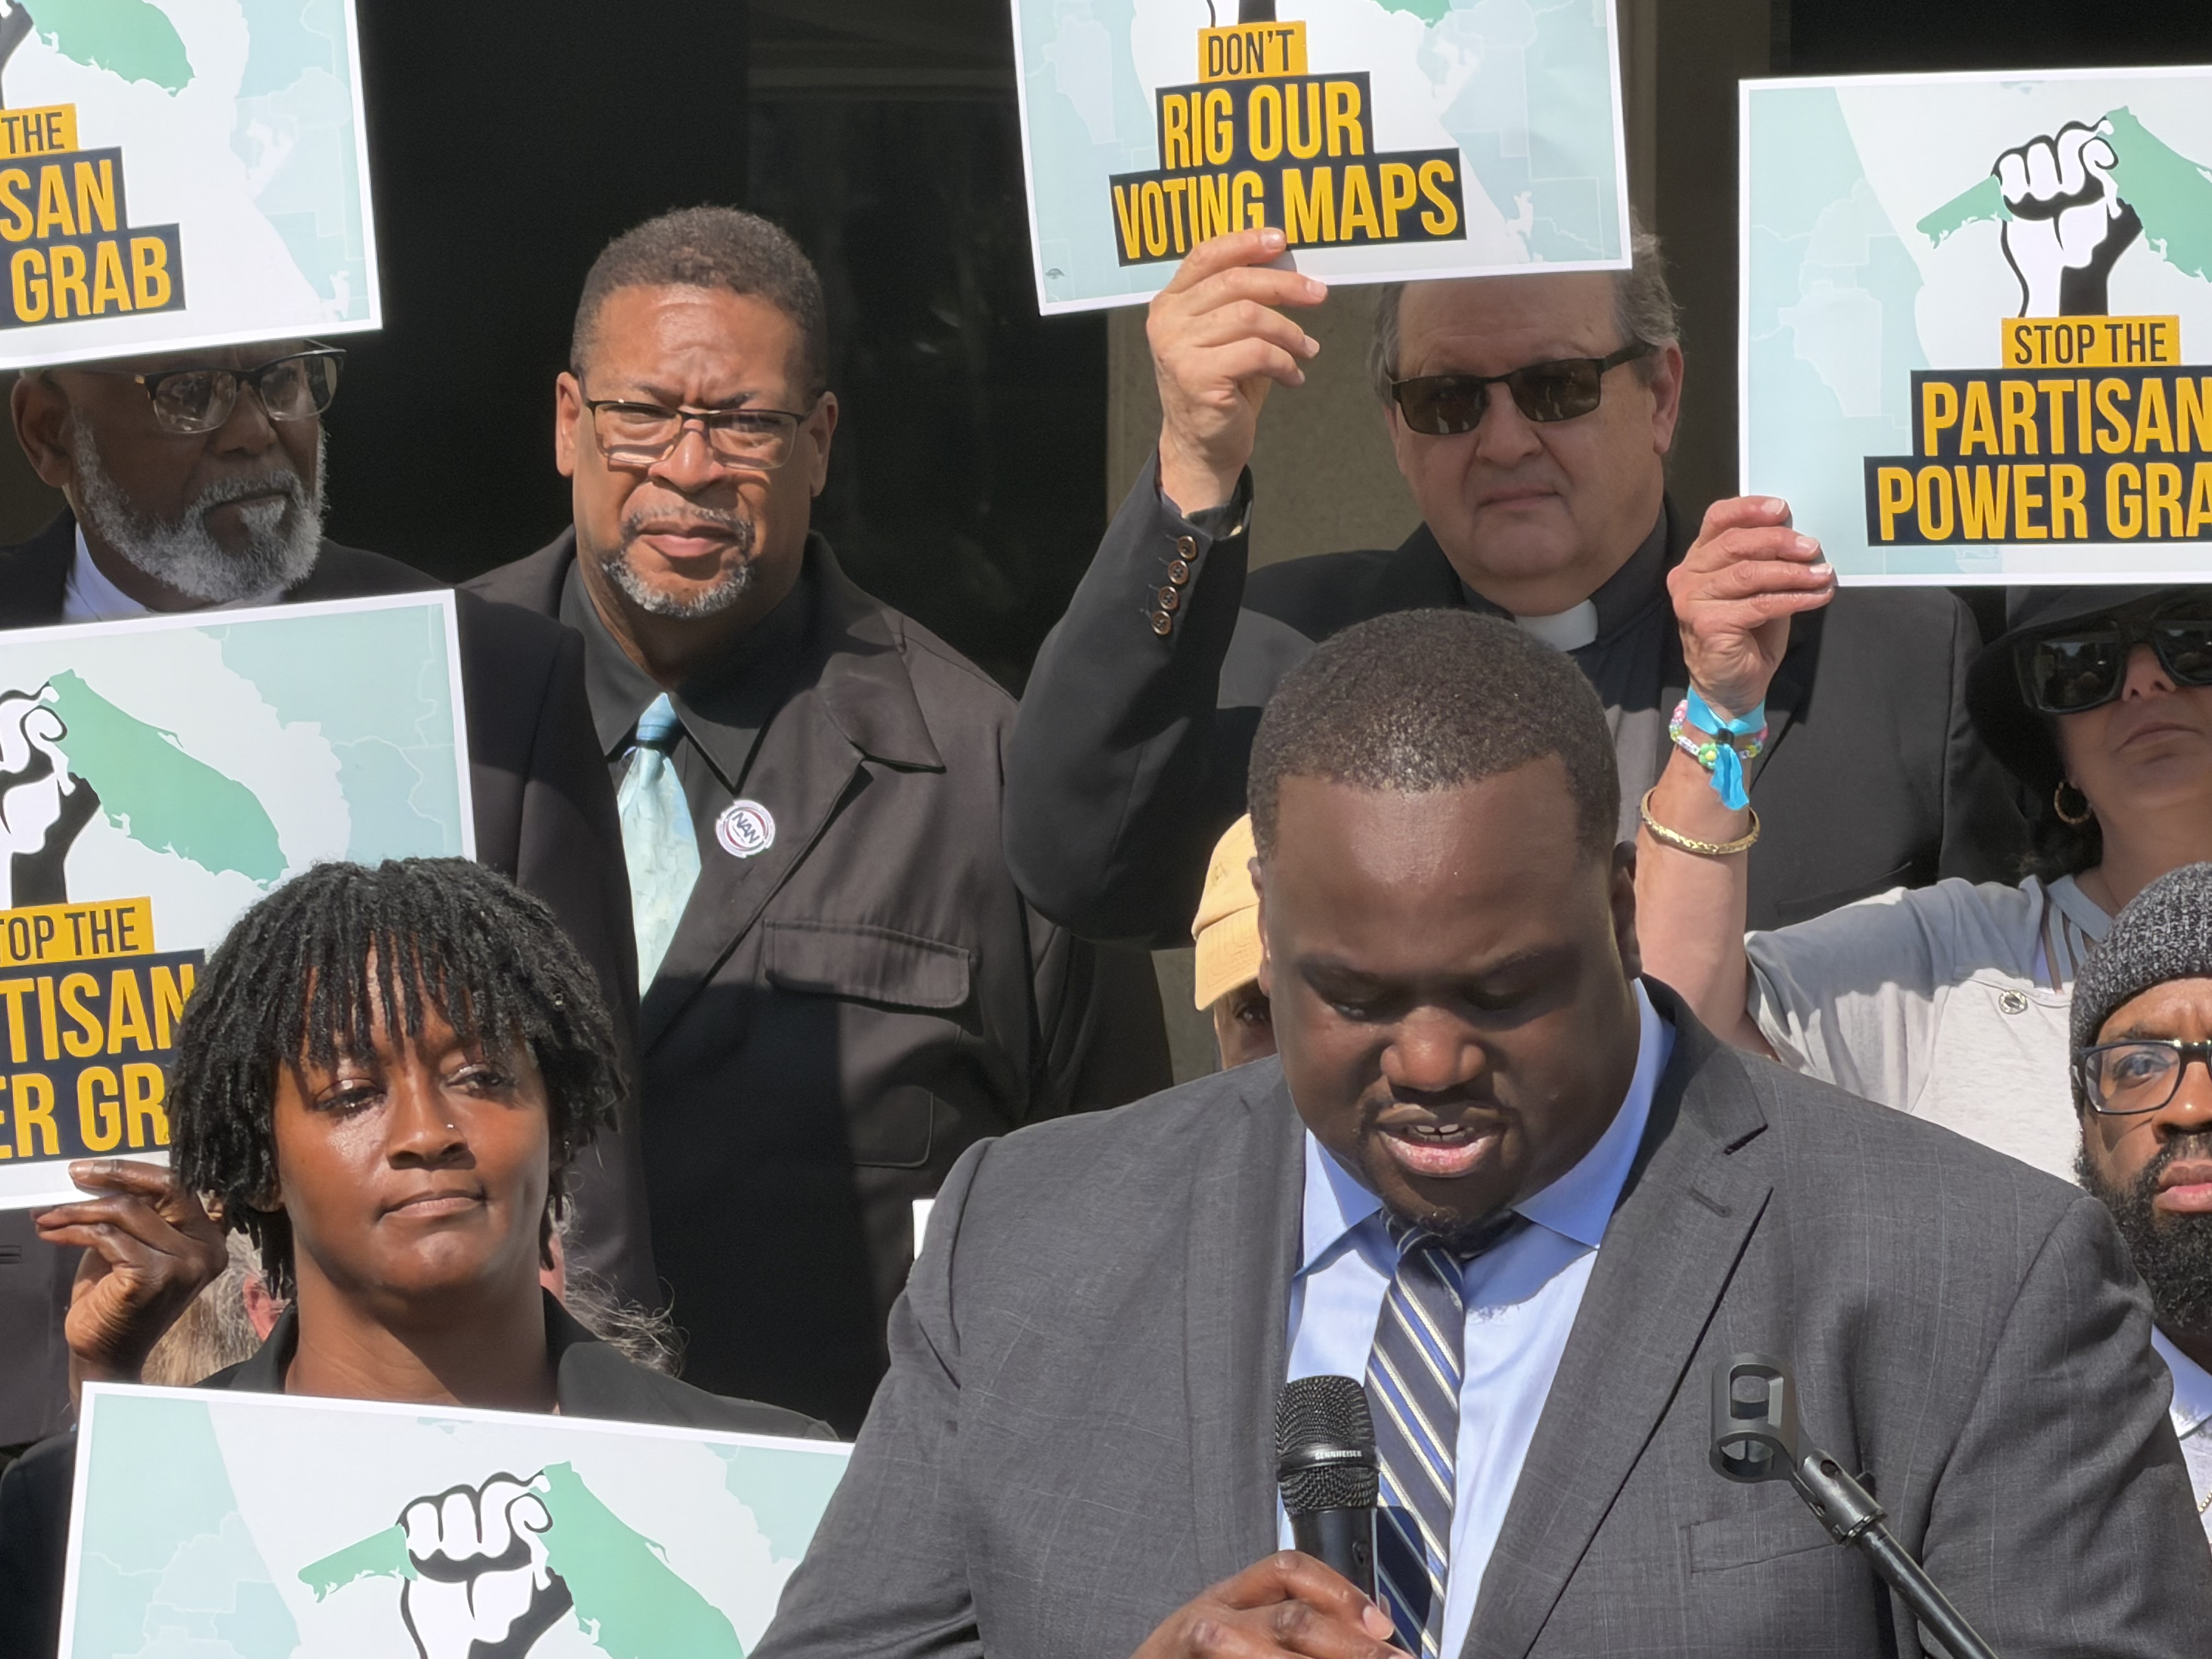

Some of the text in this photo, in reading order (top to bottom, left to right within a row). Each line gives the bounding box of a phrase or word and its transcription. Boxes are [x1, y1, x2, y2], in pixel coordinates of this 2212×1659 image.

[1208, 29, 1295, 77] DON'T
[1, 111, 65, 154] THE
[1164, 81, 1365, 170] RIG OUR
[0, 160, 117, 241] SAN
[1113, 160, 1458, 260] VOTING MAPS
[11, 237, 171, 323] GRAB
[2015, 323, 2168, 364] STOP THE
[1922, 377, 2212, 456] PARTISAN
[1878, 462, 2212, 541] POWER GRA
[0, 906, 139, 961] OP THE
[0, 963, 195, 1063] TISAN
